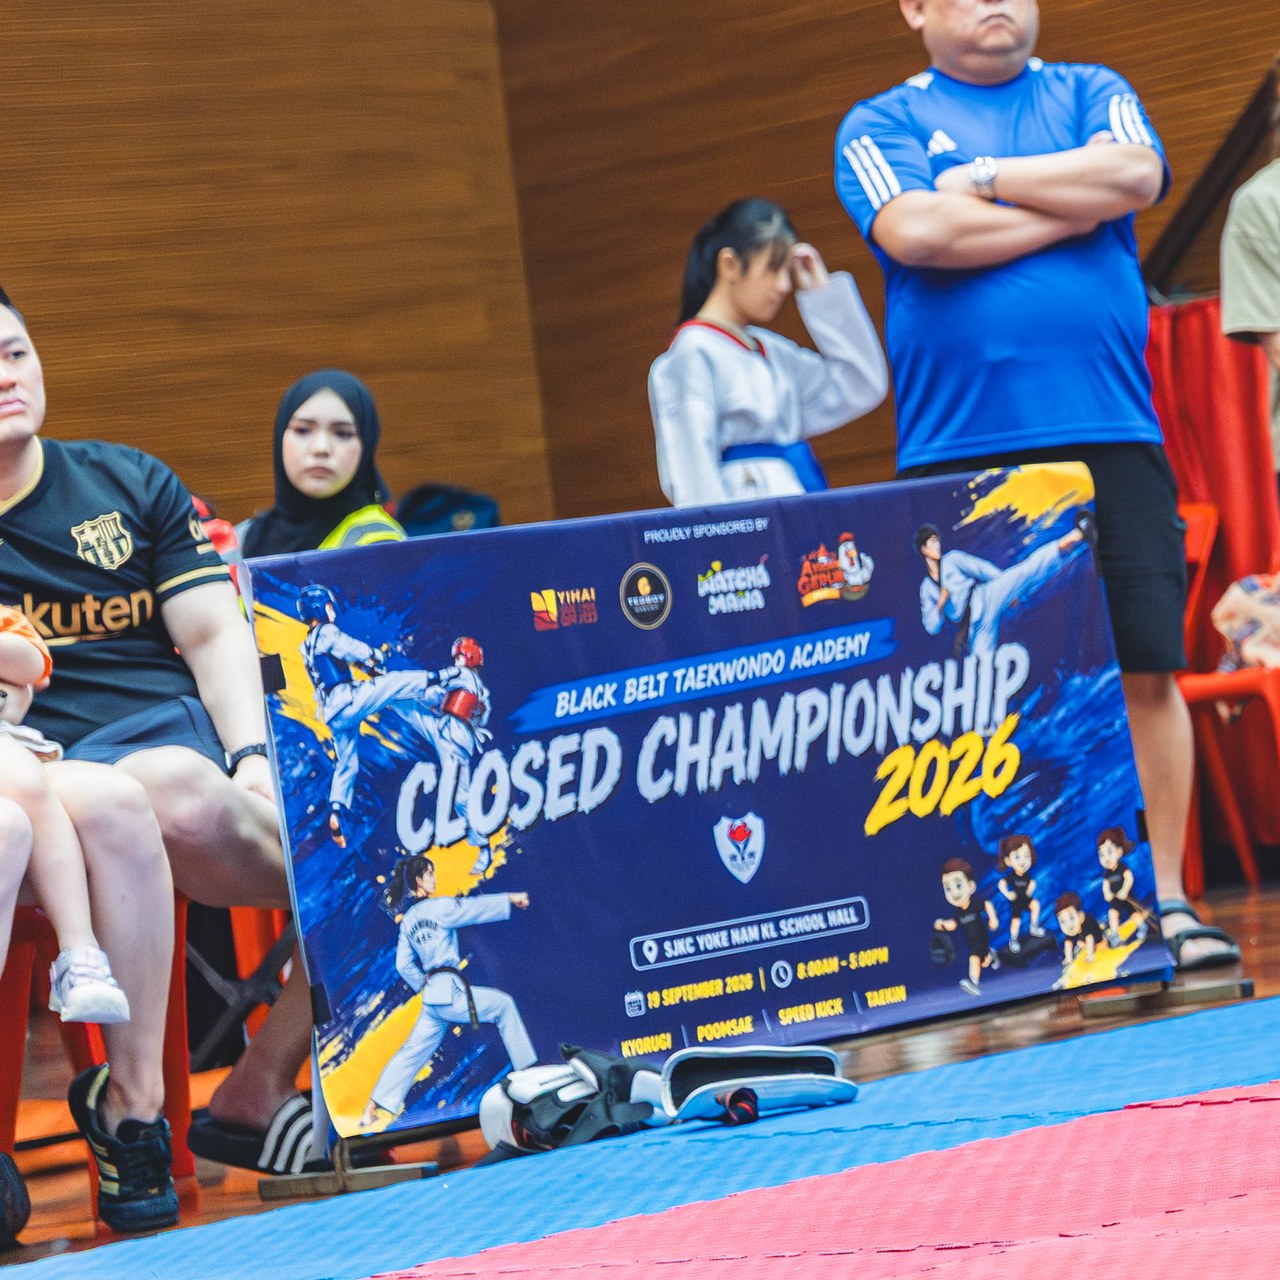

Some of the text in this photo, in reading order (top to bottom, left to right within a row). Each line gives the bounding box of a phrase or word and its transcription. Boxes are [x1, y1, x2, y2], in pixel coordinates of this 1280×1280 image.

[644, 517, 769, 544] PROUDLY SPONSORED BY
[14, 588, 153, 638] kuten
[555, 631, 871, 718] BLACK BELT TAEKWONDO ACADEMY
[395, 642, 1029, 854] CLOSED CHAMPIONSHIP
[864, 713, 1021, 837] 2026
[663, 906, 859, 959] SJKC YOKE NAM KL SCHOOL HALL
[661, 978, 724, 1007] SEPTEMBER
[621, 1031, 673, 1059] KYORUGI
[696, 1015, 755, 1043] POOMSAE
[777, 1005, 815, 1026] SPEED
[815, 997, 845, 1020] KICK
